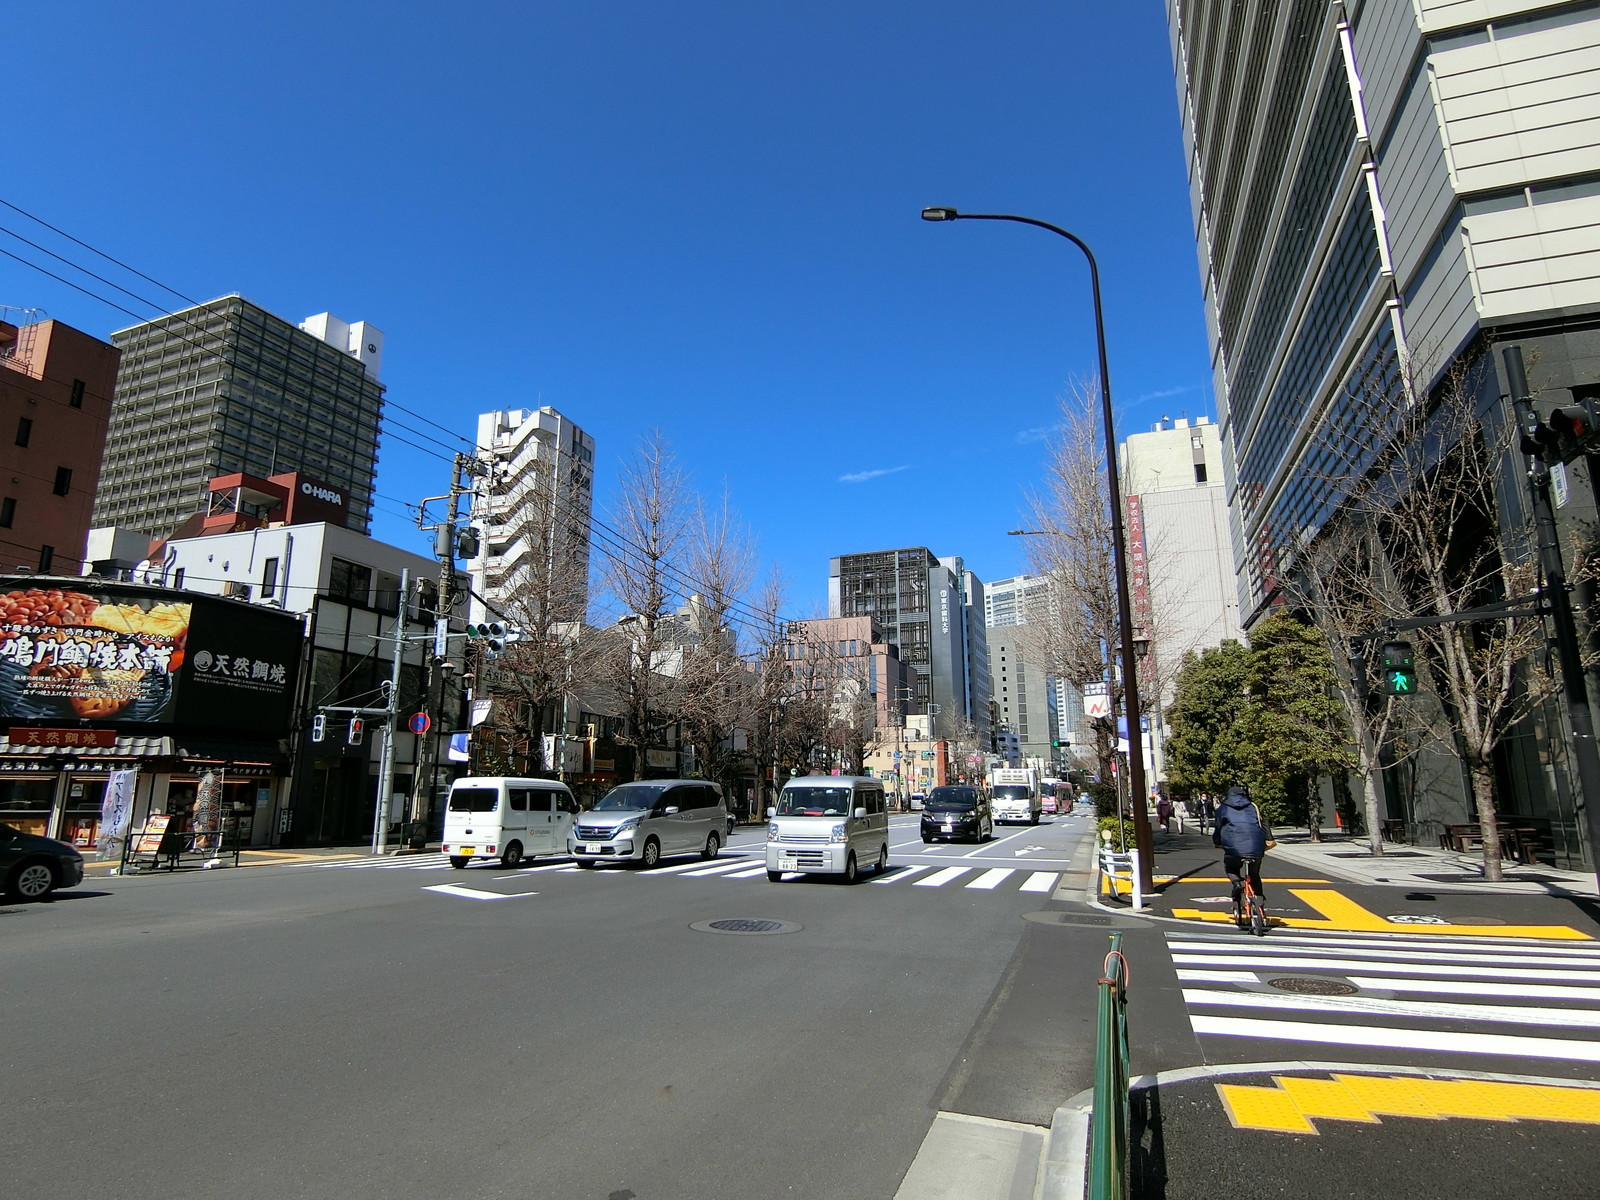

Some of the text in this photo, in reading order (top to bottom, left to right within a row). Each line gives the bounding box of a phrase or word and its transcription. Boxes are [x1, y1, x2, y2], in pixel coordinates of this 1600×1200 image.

[124, 633, 174, 643] アイスもなか
[0, 636, 174, 675] 鳴門鯛焼本舗
[213, 654, 286, 684] 天然鯛焼
[27, 731, 98, 745] 天然鯛焼
